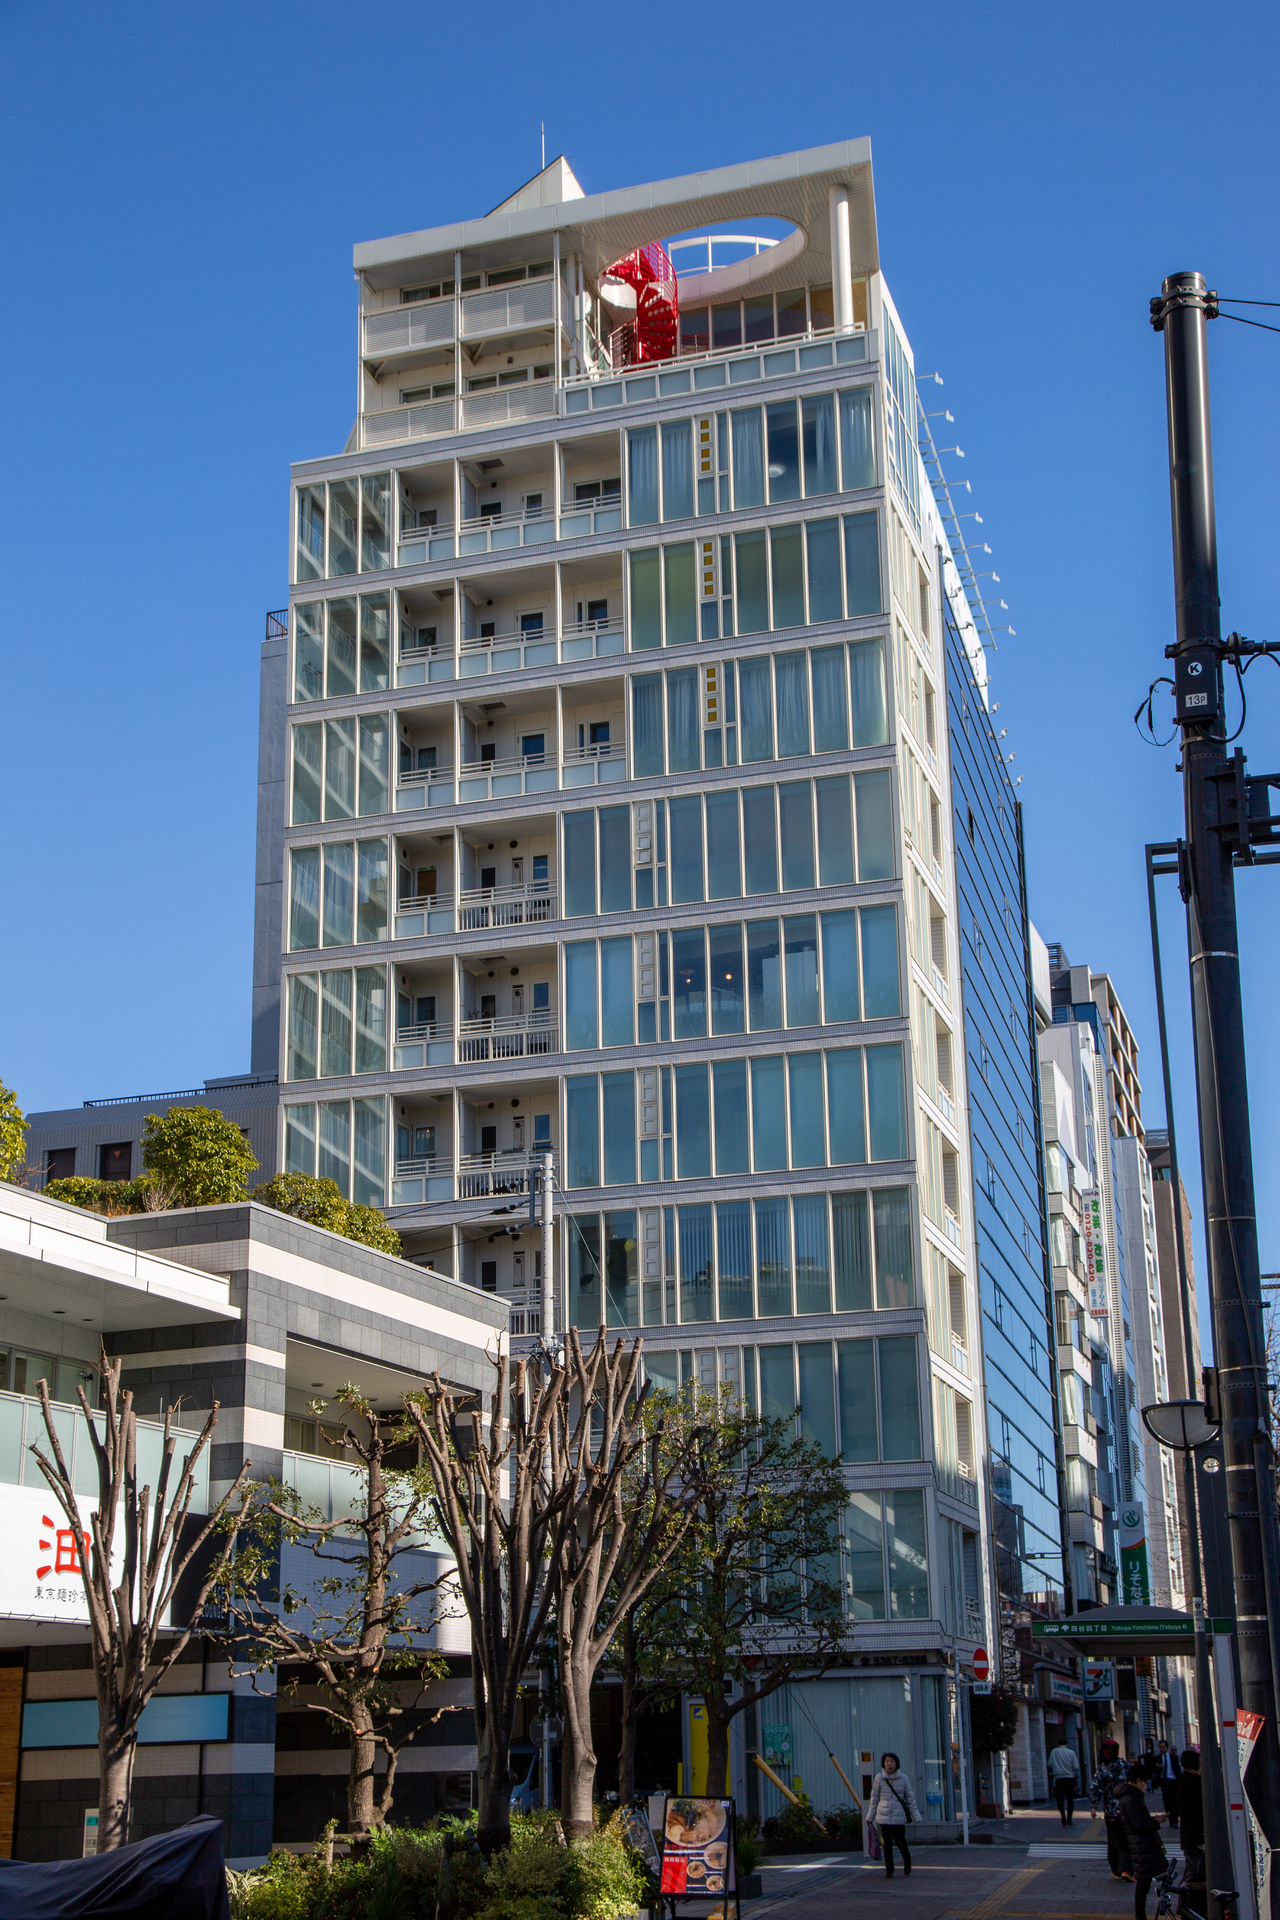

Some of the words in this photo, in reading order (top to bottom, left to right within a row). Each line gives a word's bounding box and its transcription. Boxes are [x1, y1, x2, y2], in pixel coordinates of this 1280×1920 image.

[1190, 664, 1200, 674] K
[1188, 695, 1206, 706] 13P
[1084, 1213, 1095, 1282] 0120-820-620
[1071, 1624, 1107, 1632] 四谷四丁目
